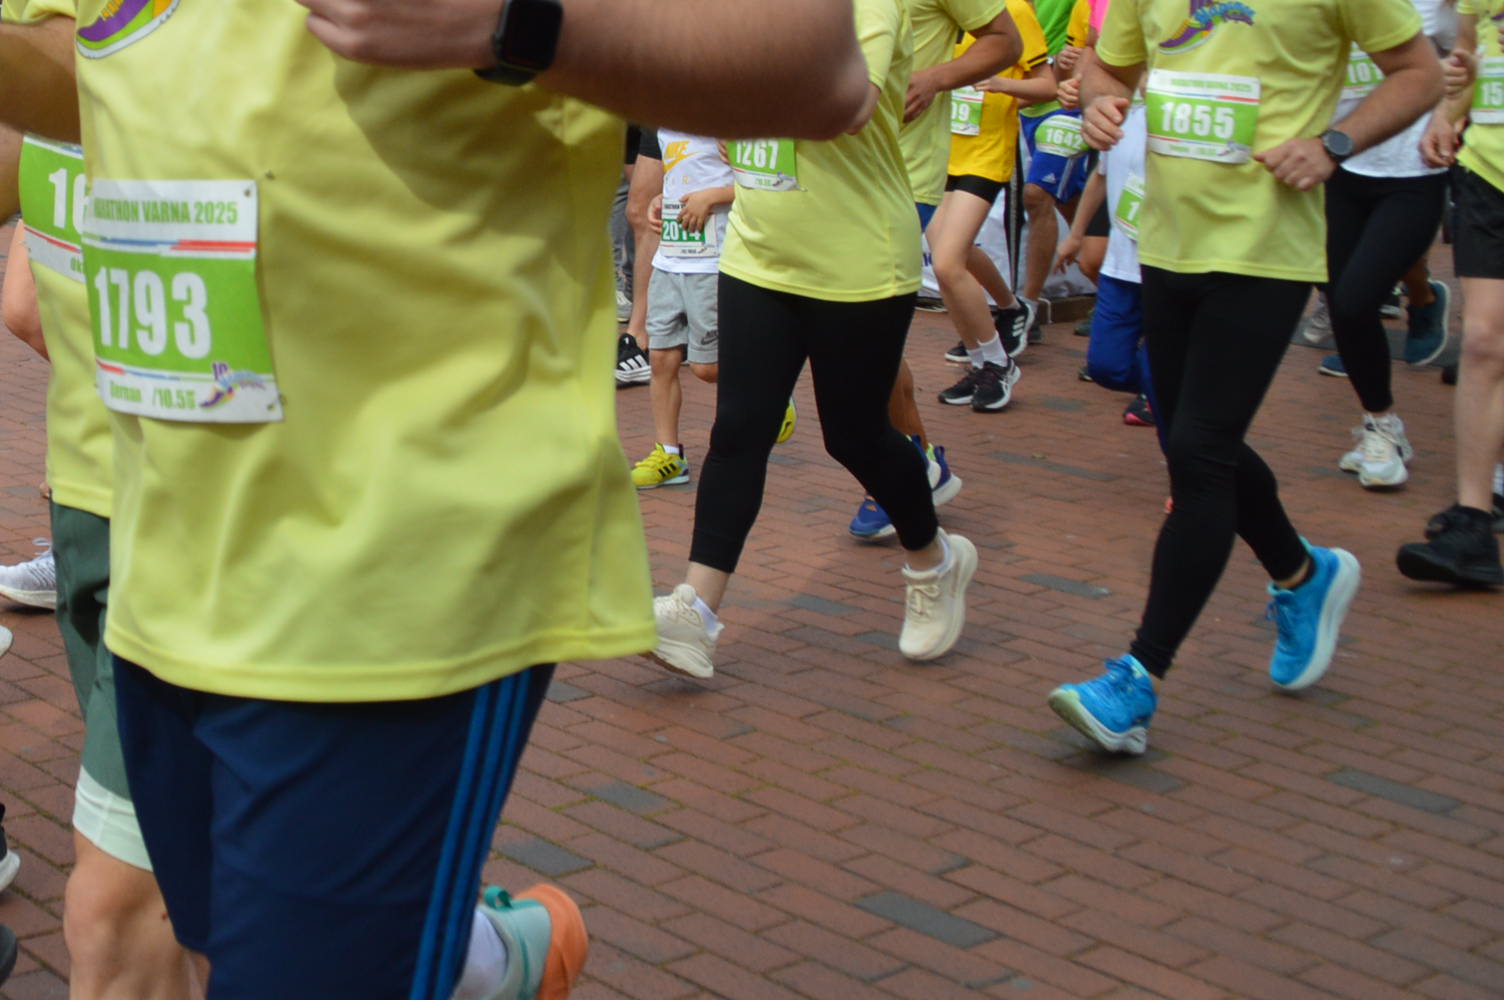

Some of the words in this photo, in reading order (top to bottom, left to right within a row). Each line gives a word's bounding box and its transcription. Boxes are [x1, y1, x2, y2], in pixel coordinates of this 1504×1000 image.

[1160, 101, 1235, 139] 1855
[1046, 127, 1084, 150] 1642
[736, 139, 779, 170] 1267
[194, 201, 238, 225] 2025
[94, 266, 212, 359] 1793
